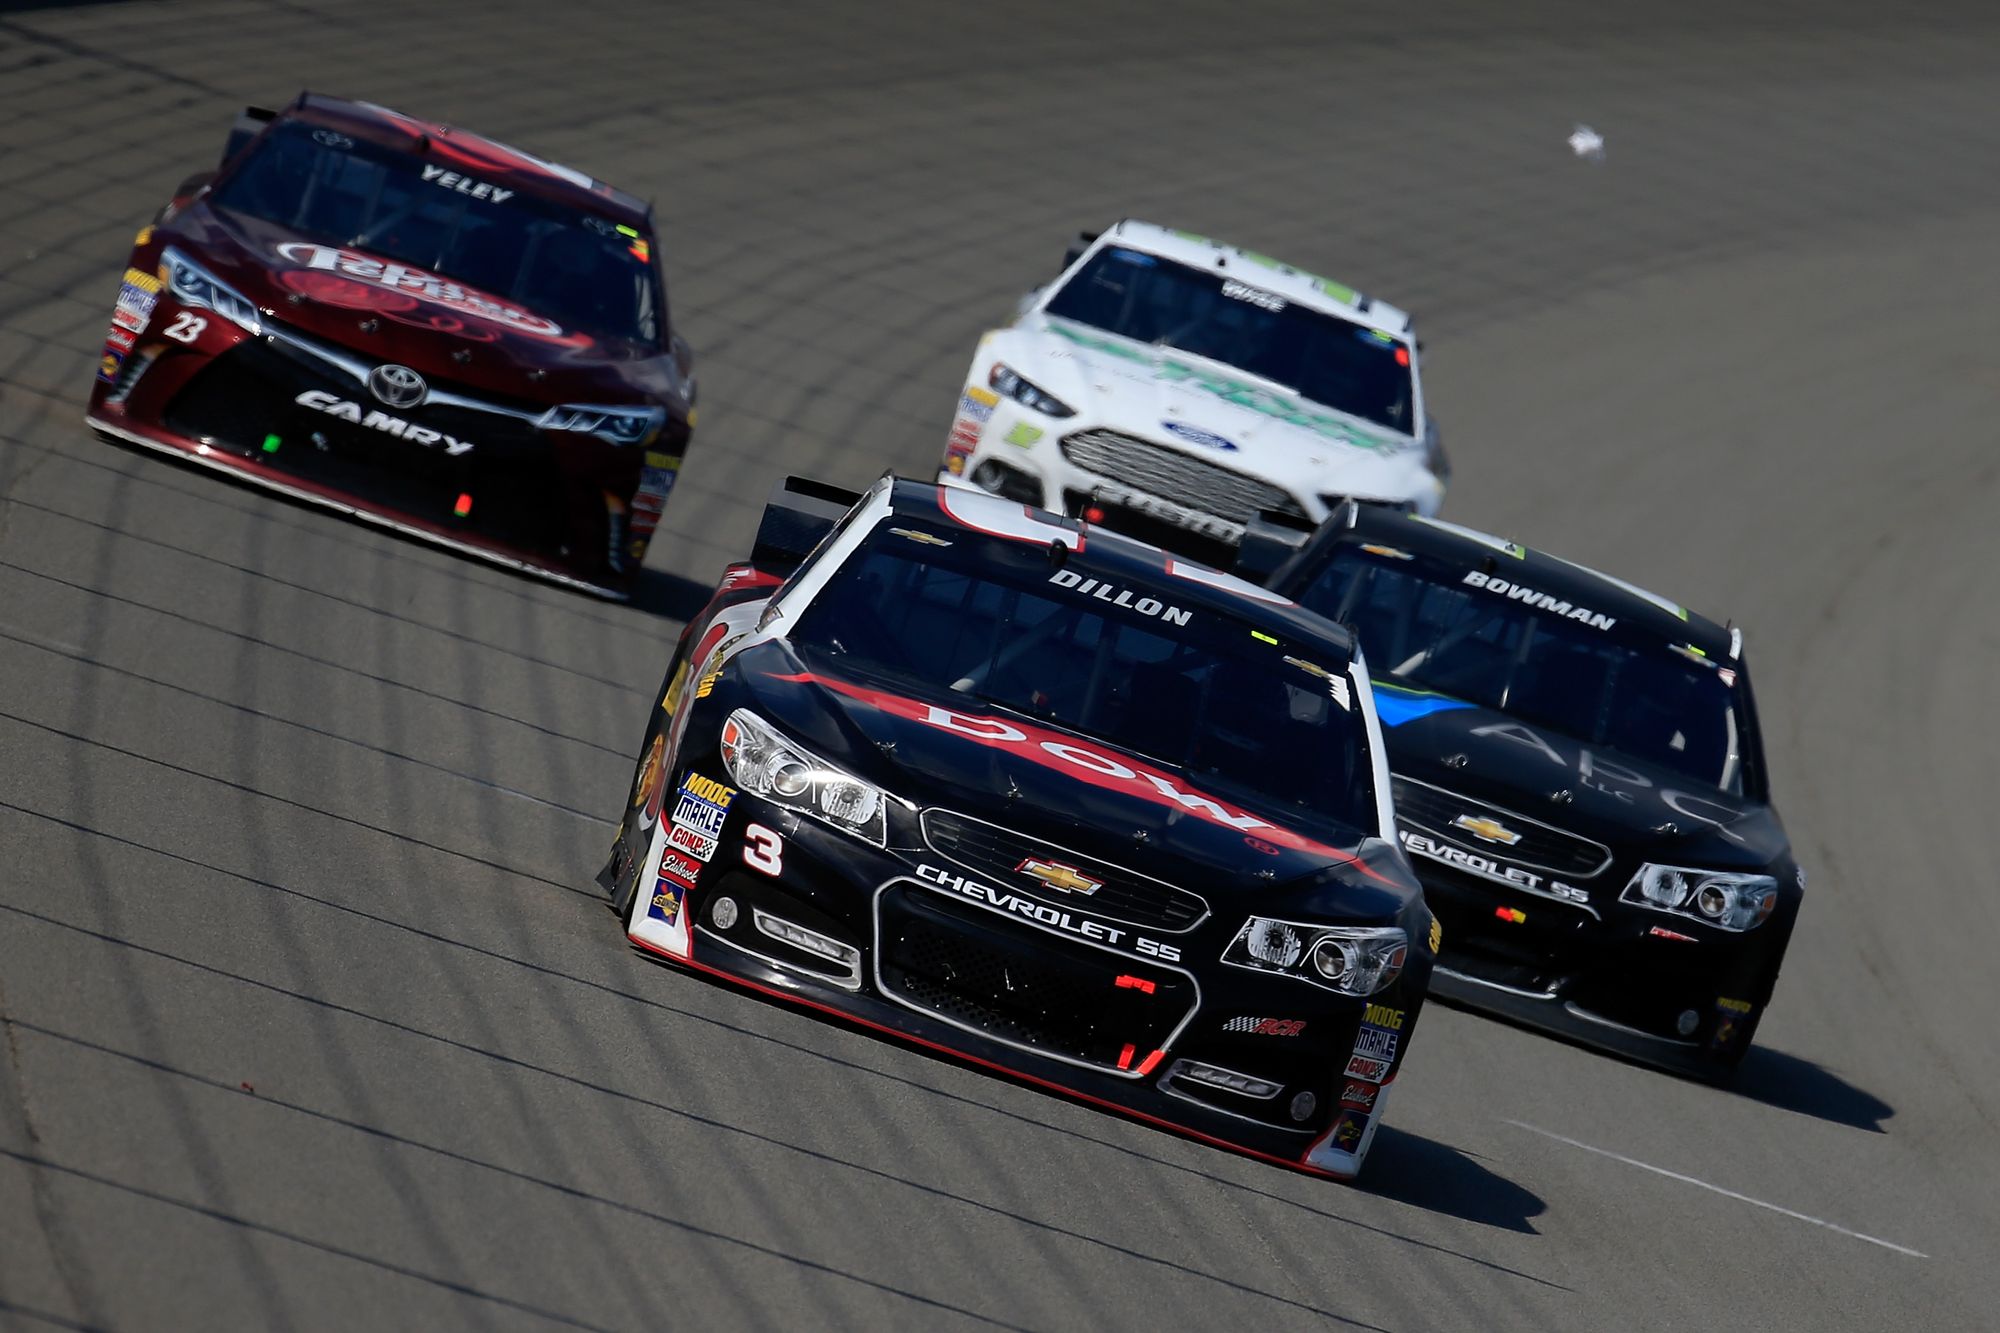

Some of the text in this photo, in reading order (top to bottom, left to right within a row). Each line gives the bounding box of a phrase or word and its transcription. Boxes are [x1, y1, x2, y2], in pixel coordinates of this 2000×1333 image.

[421, 164, 514, 204] YELEY
[163, 310, 208, 344] 23
[295, 389, 475, 456] CAMRY
[1049, 569, 1193, 627] DILLON
[1462, 570, 1617, 632] BOWMAN
[682, 772, 738, 808] MOOG
[918, 703, 1276, 832] DOW
[672, 827, 704, 850] COMP
[676, 796, 724, 834] MAHLE
[743, 822, 783, 878] 3
[1399, 830, 1591, 903] EVROLET SS
[915, 863, 1181, 962] CHEVROLET SS
[1361, 1002, 1405, 1030] MOOG
[1355, 1028, 1397, 1058] MAHLE
